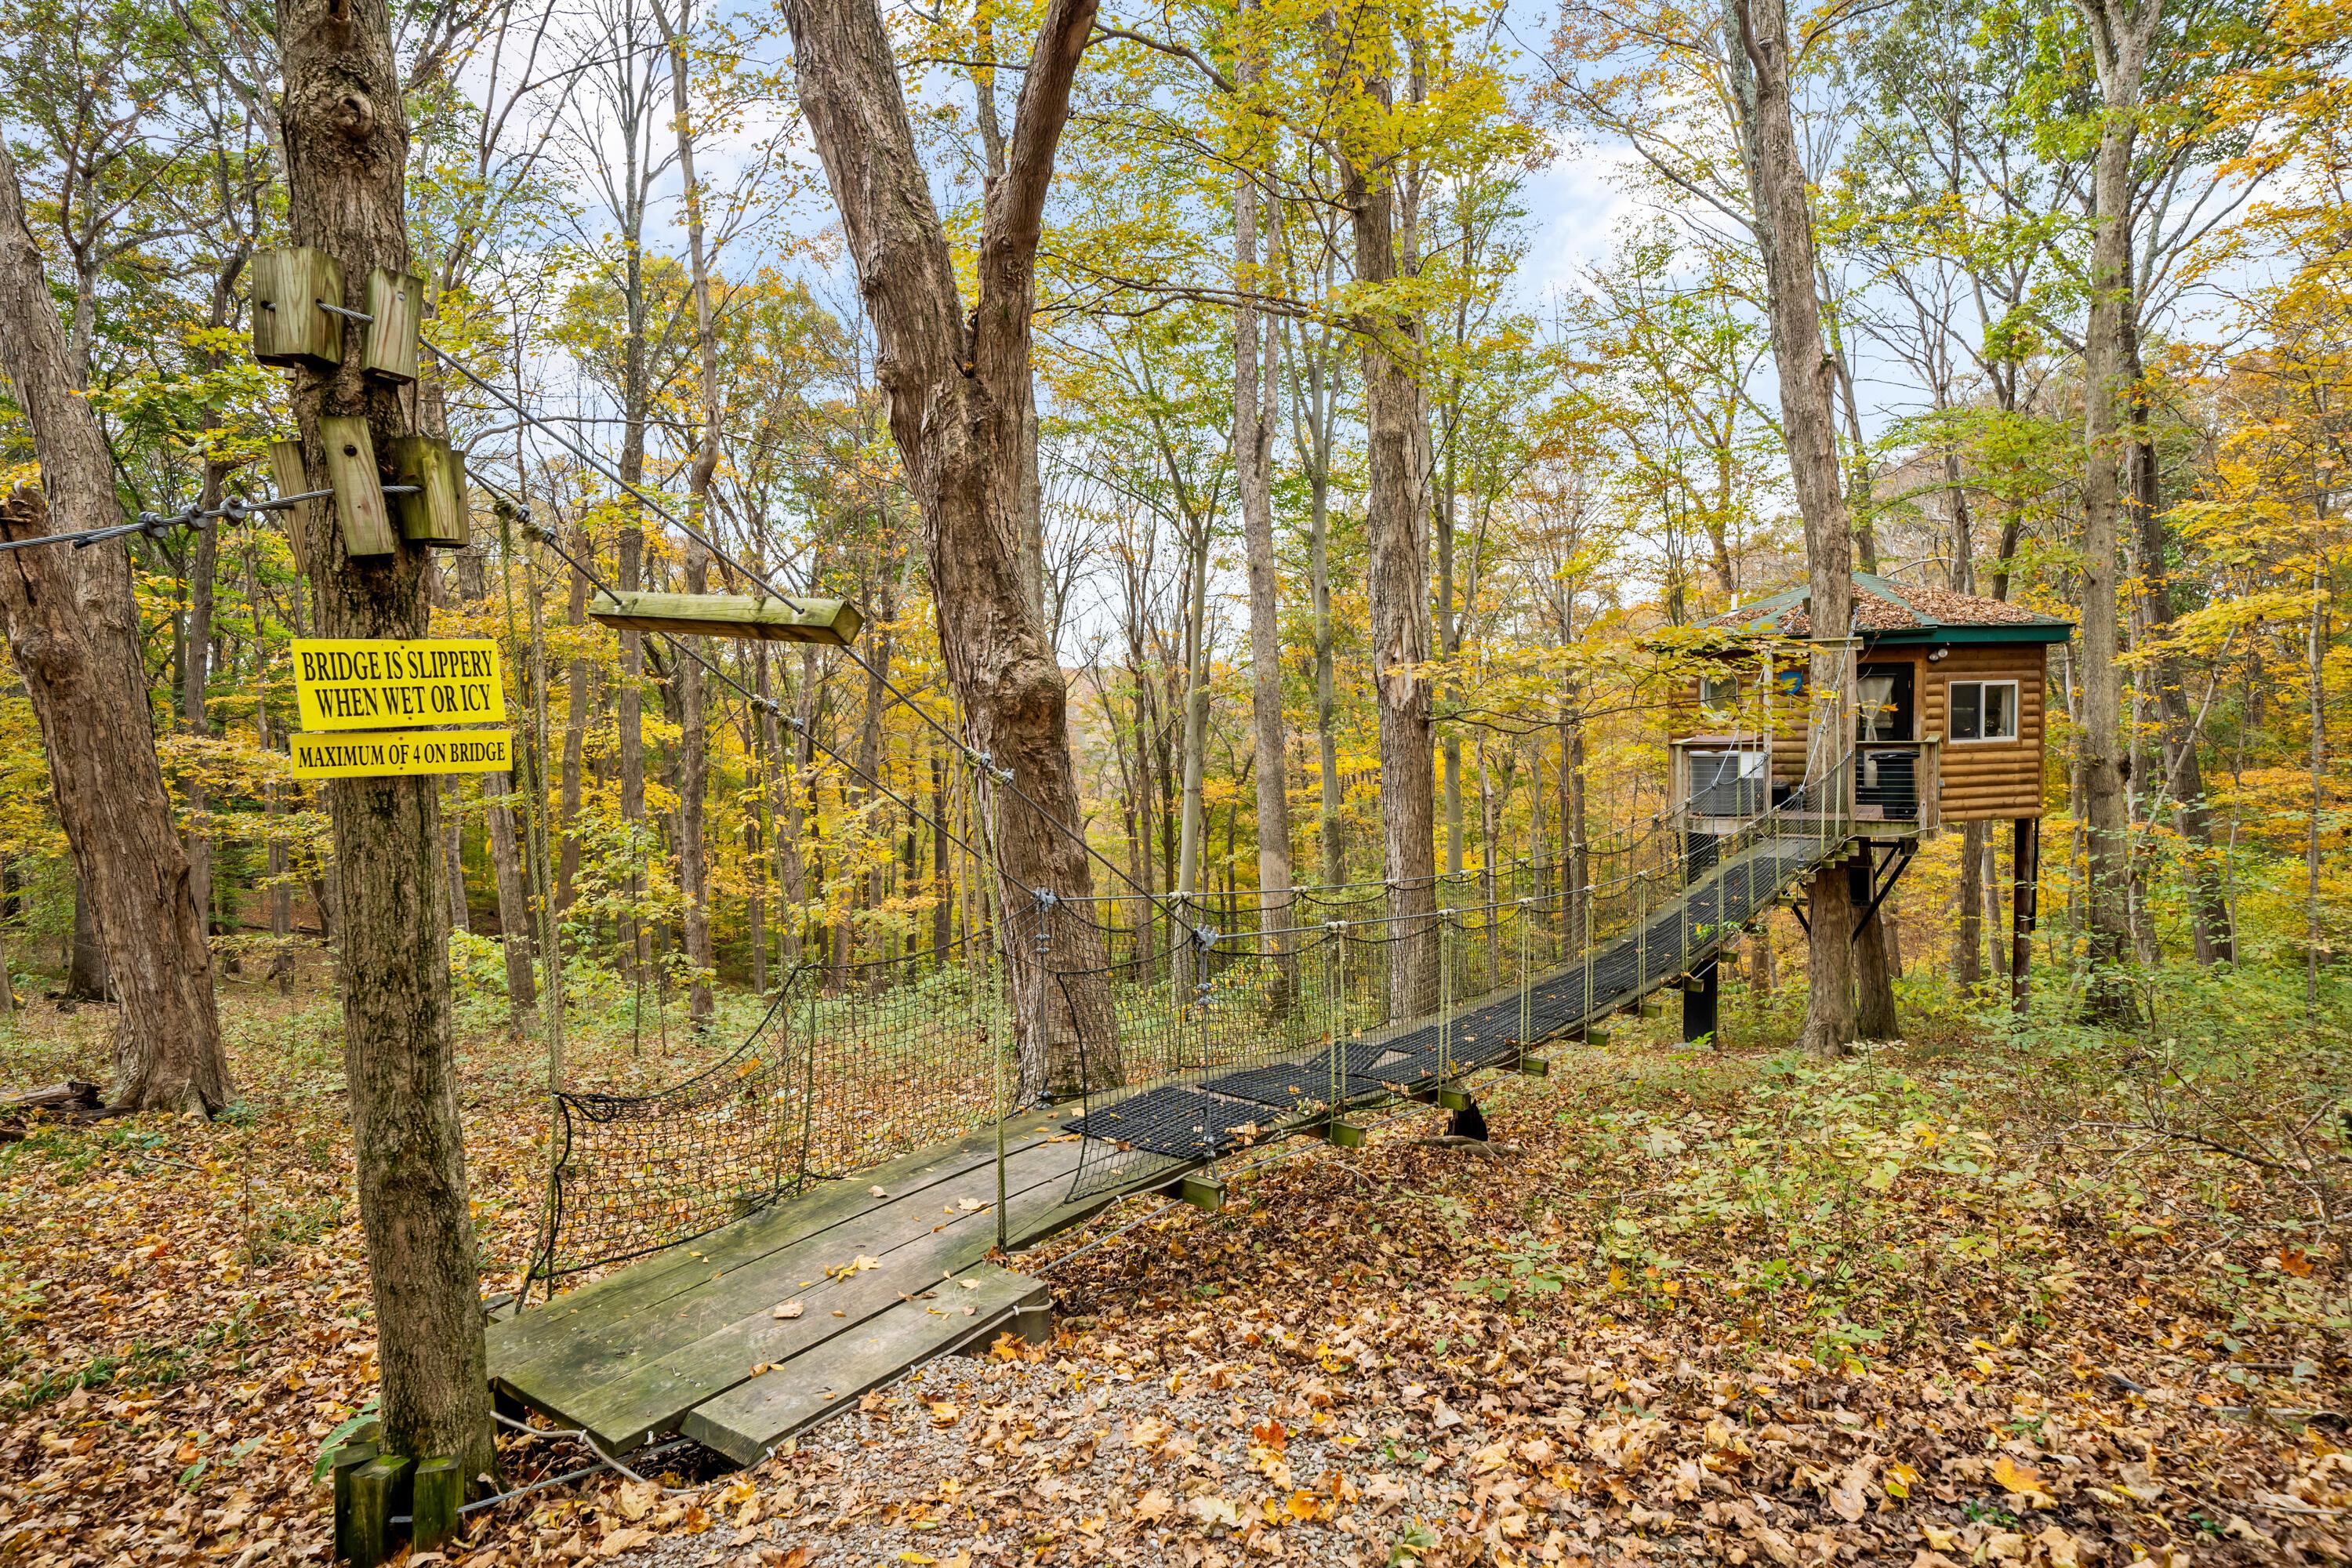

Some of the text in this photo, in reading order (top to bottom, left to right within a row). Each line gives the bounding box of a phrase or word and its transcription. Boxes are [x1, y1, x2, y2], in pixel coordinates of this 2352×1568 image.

[301, 650, 493, 681] BRIDGE IS SLIPPERY
[315, 684, 491, 719] WHEN WET OR ICY
[299, 742, 506, 768] MAXIMUM OF 4 ON BRIDGE
